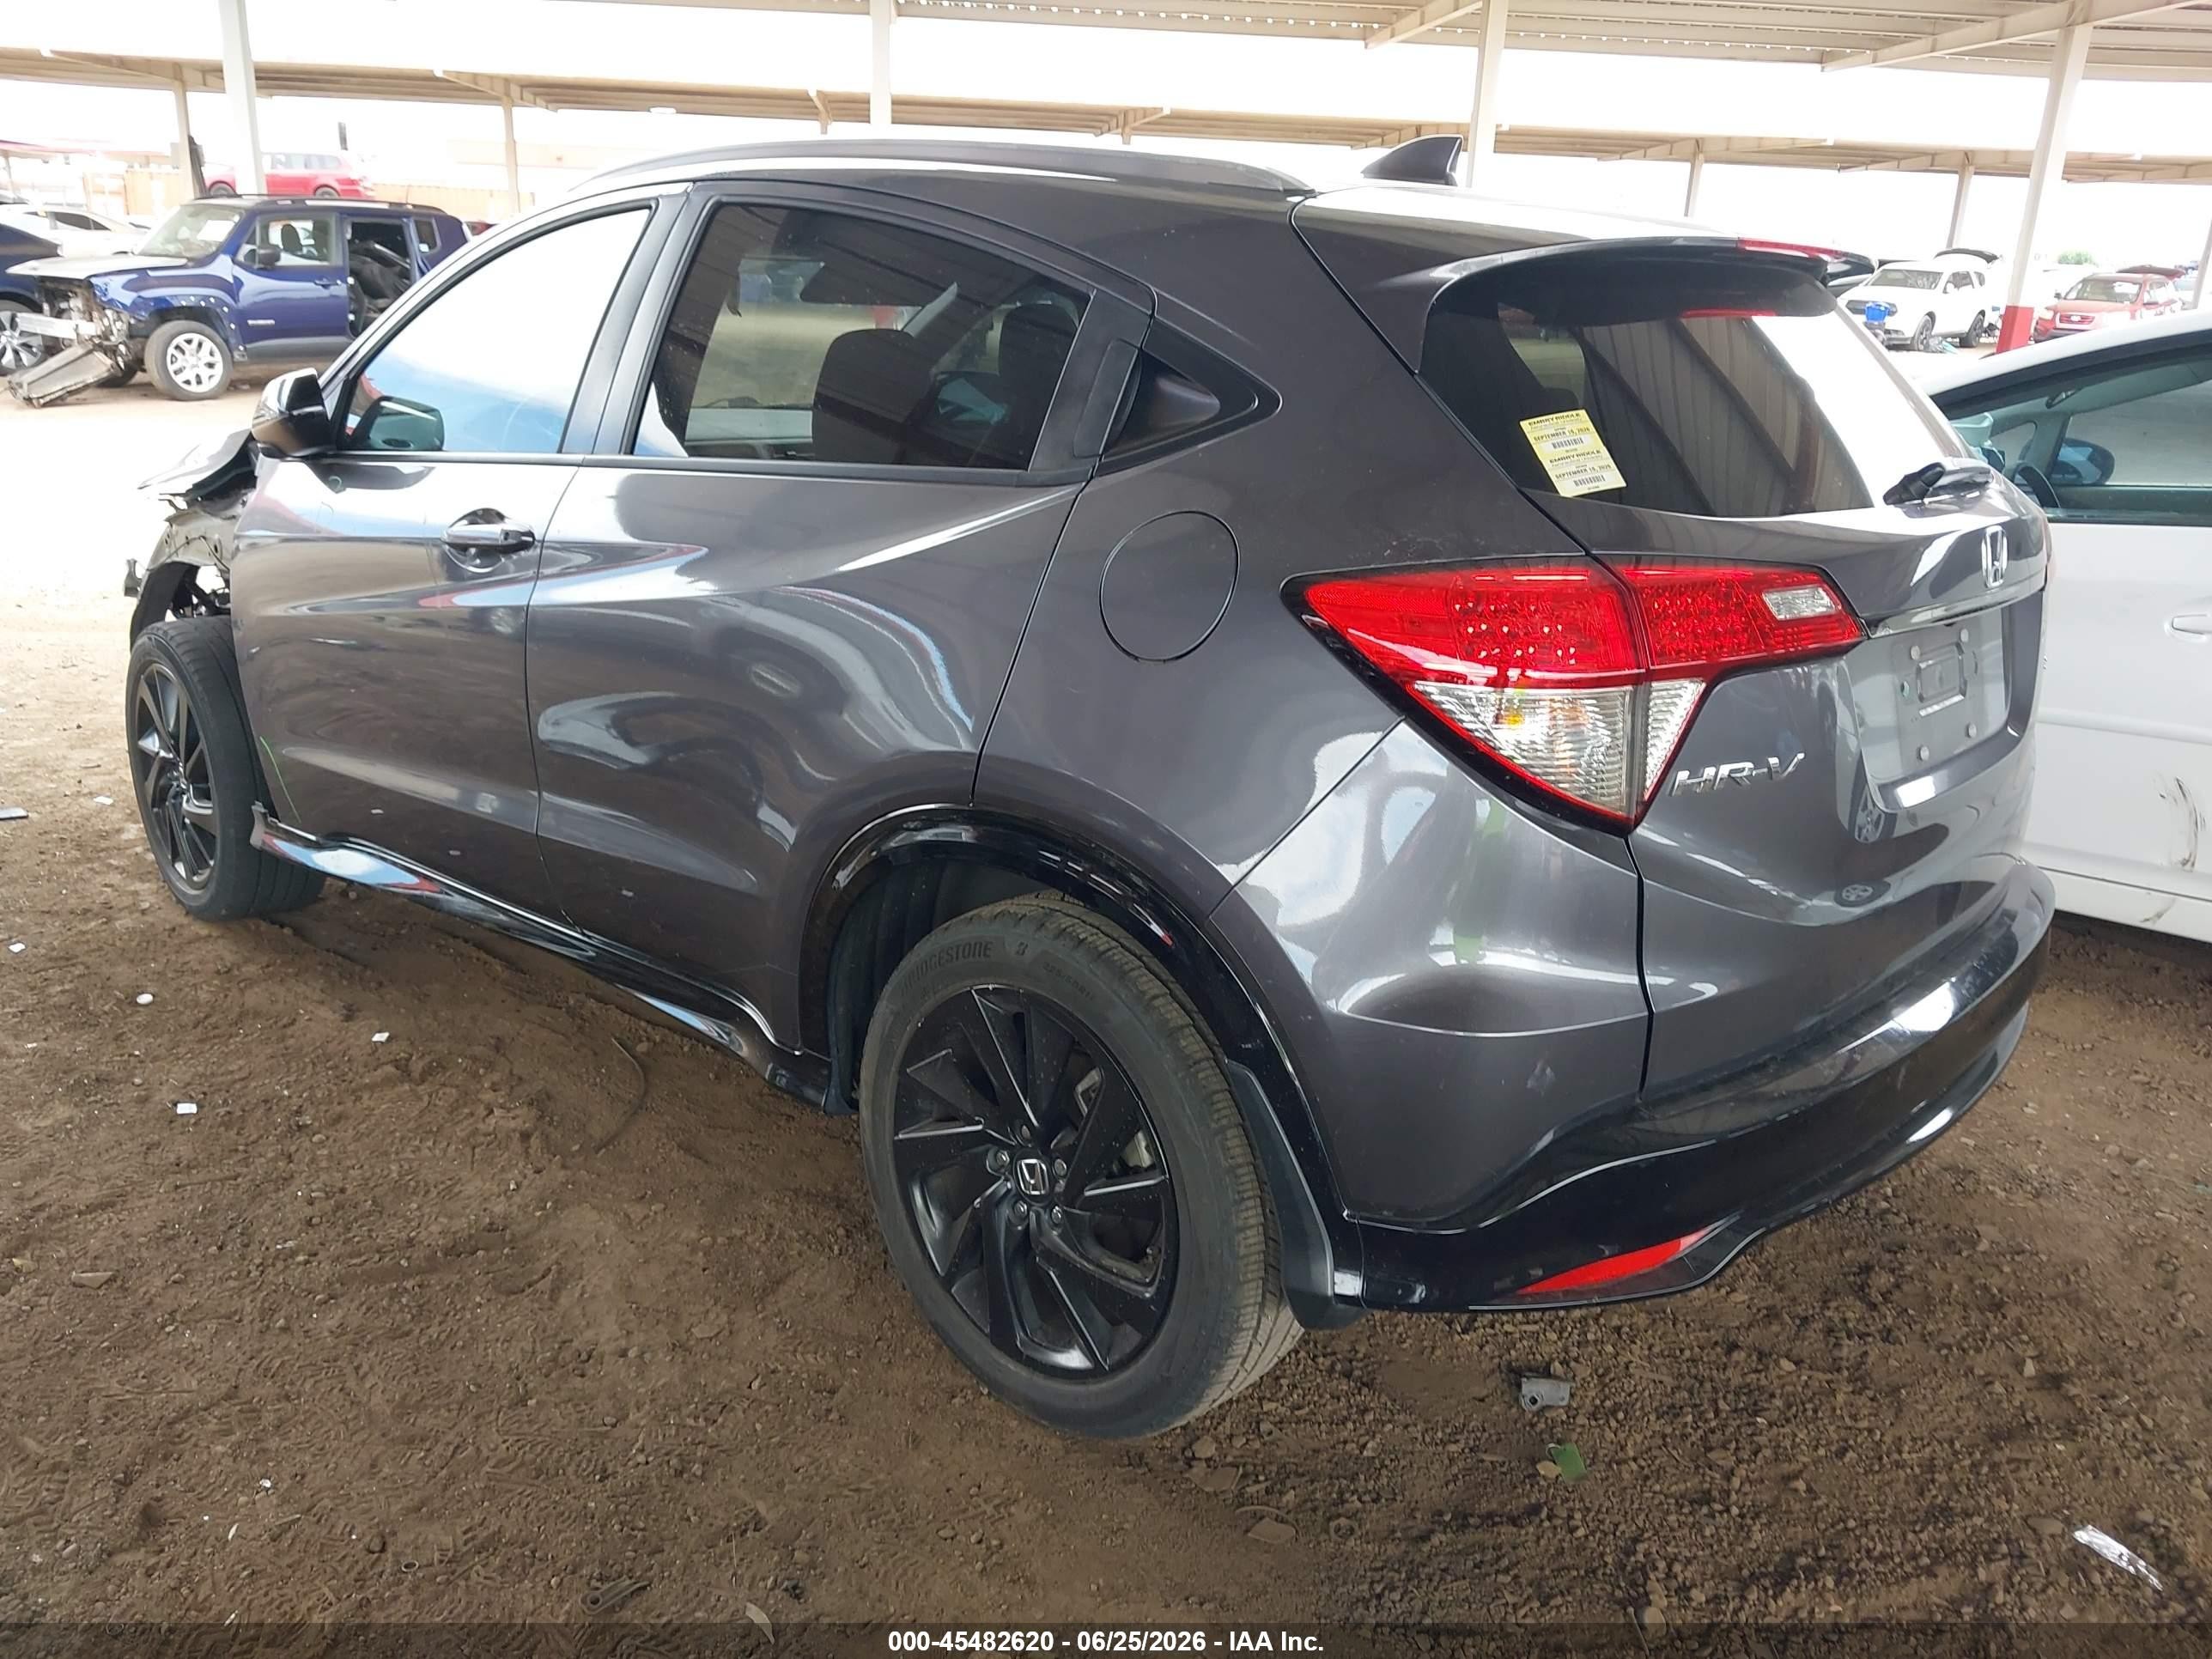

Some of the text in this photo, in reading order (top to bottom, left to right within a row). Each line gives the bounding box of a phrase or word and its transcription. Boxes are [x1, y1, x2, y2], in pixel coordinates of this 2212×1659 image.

[1534, 431, 1566, 441] SEPTEMBER
[1555, 468, 1589, 479] SEPTEMBER
[1669, 752, 1806, 797] HR-V
